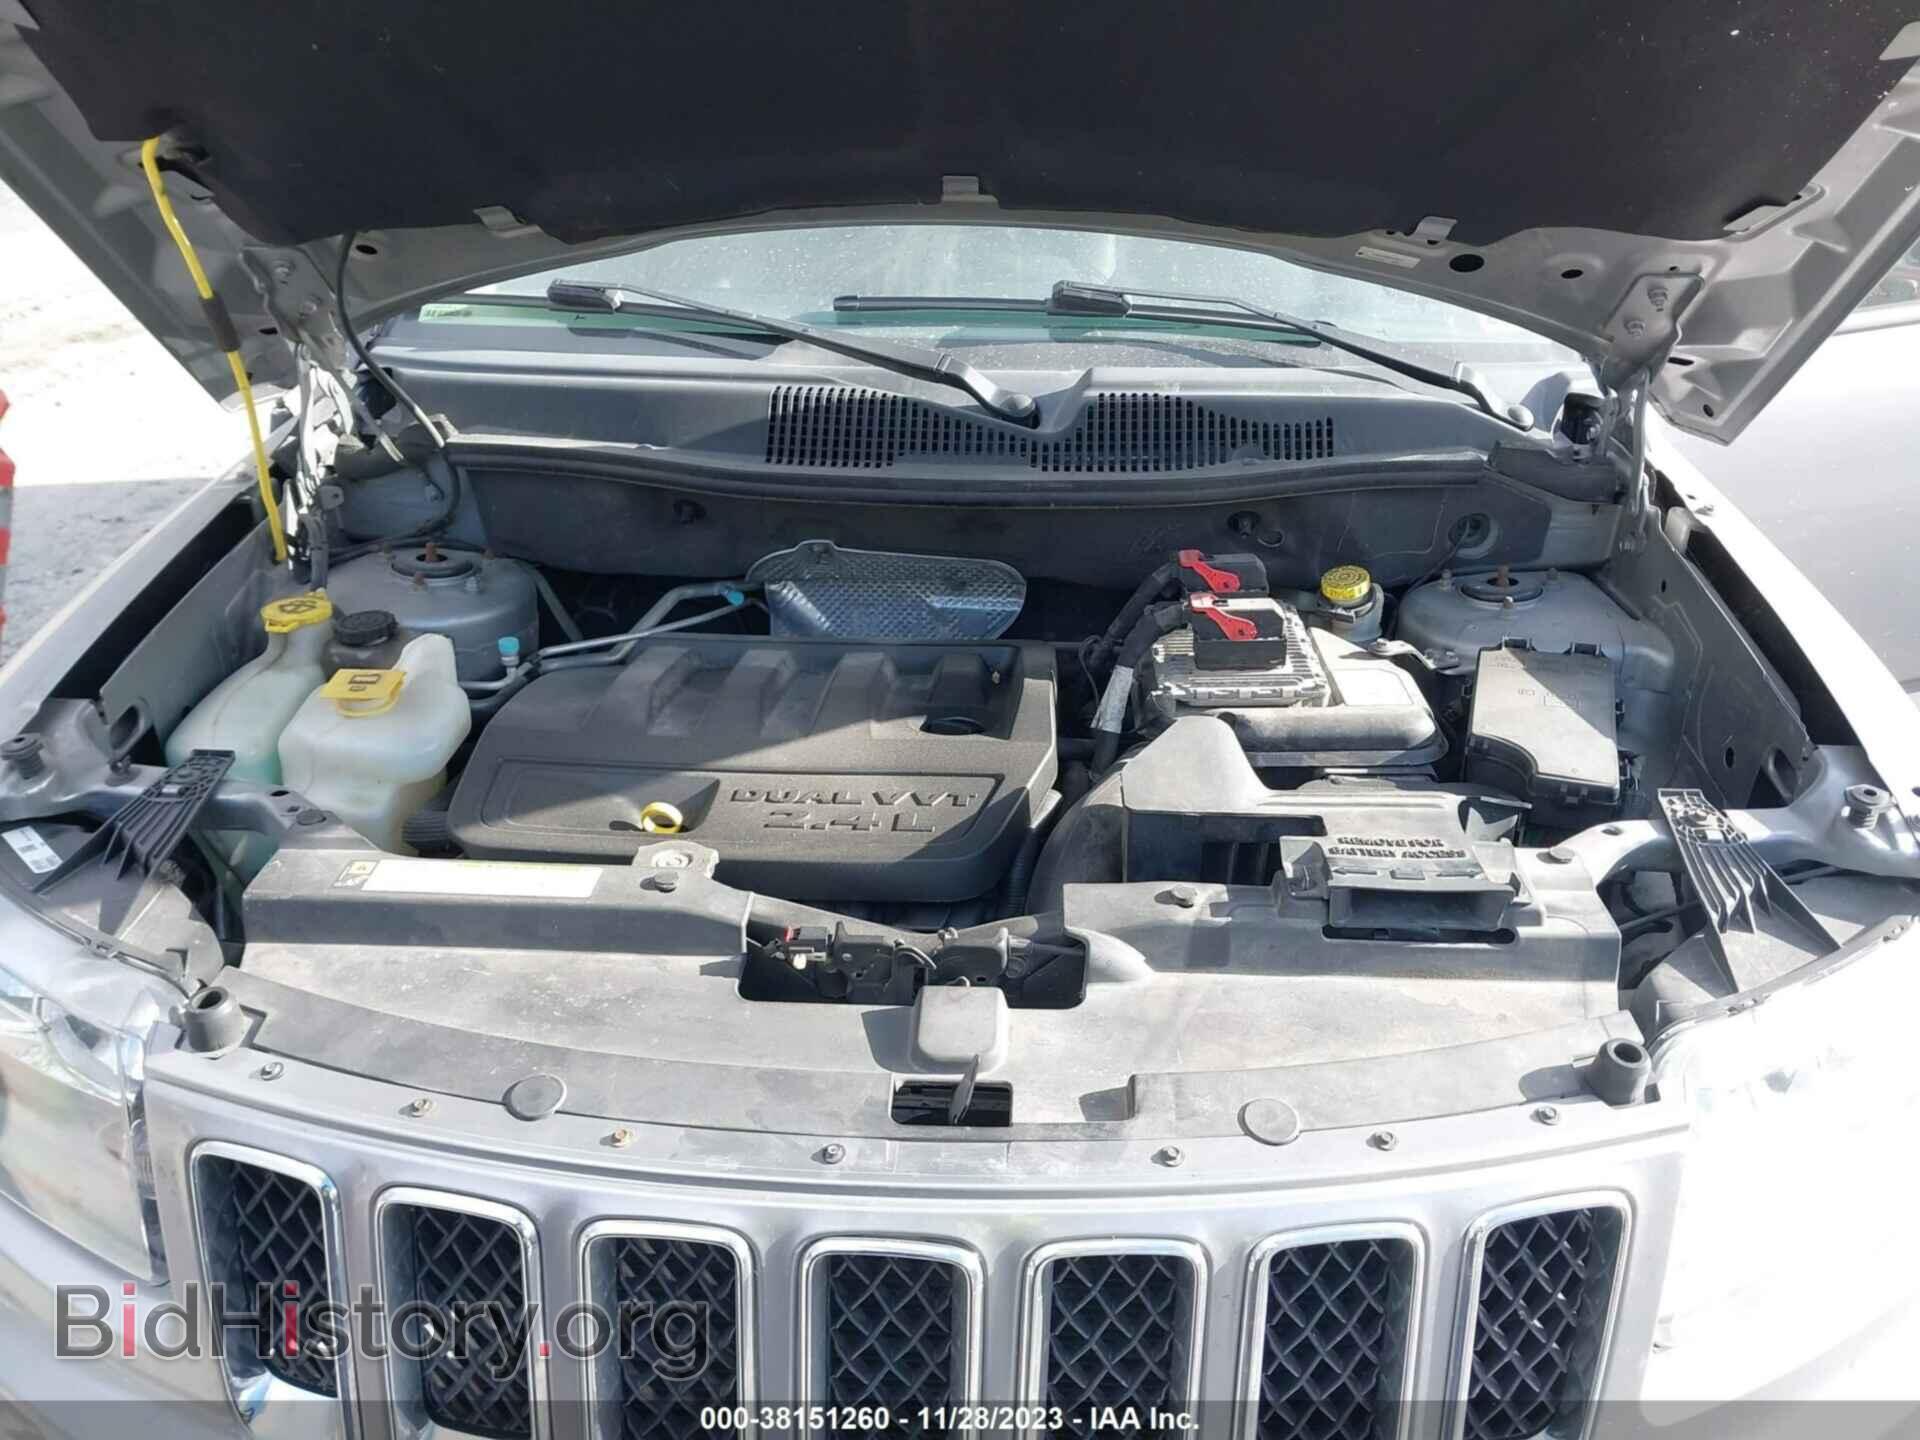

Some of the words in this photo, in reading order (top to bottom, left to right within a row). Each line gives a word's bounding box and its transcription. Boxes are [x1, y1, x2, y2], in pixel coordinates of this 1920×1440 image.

[730, 789, 864, 805] DUAL
[872, 791, 978, 807] VVT
[763, 811, 936, 833] 2.4L
[1337, 837, 1407, 848] REMOVE
[1327, 847, 1396, 858] BATTERY
[1401, 849, 1467, 859] ACCESS
